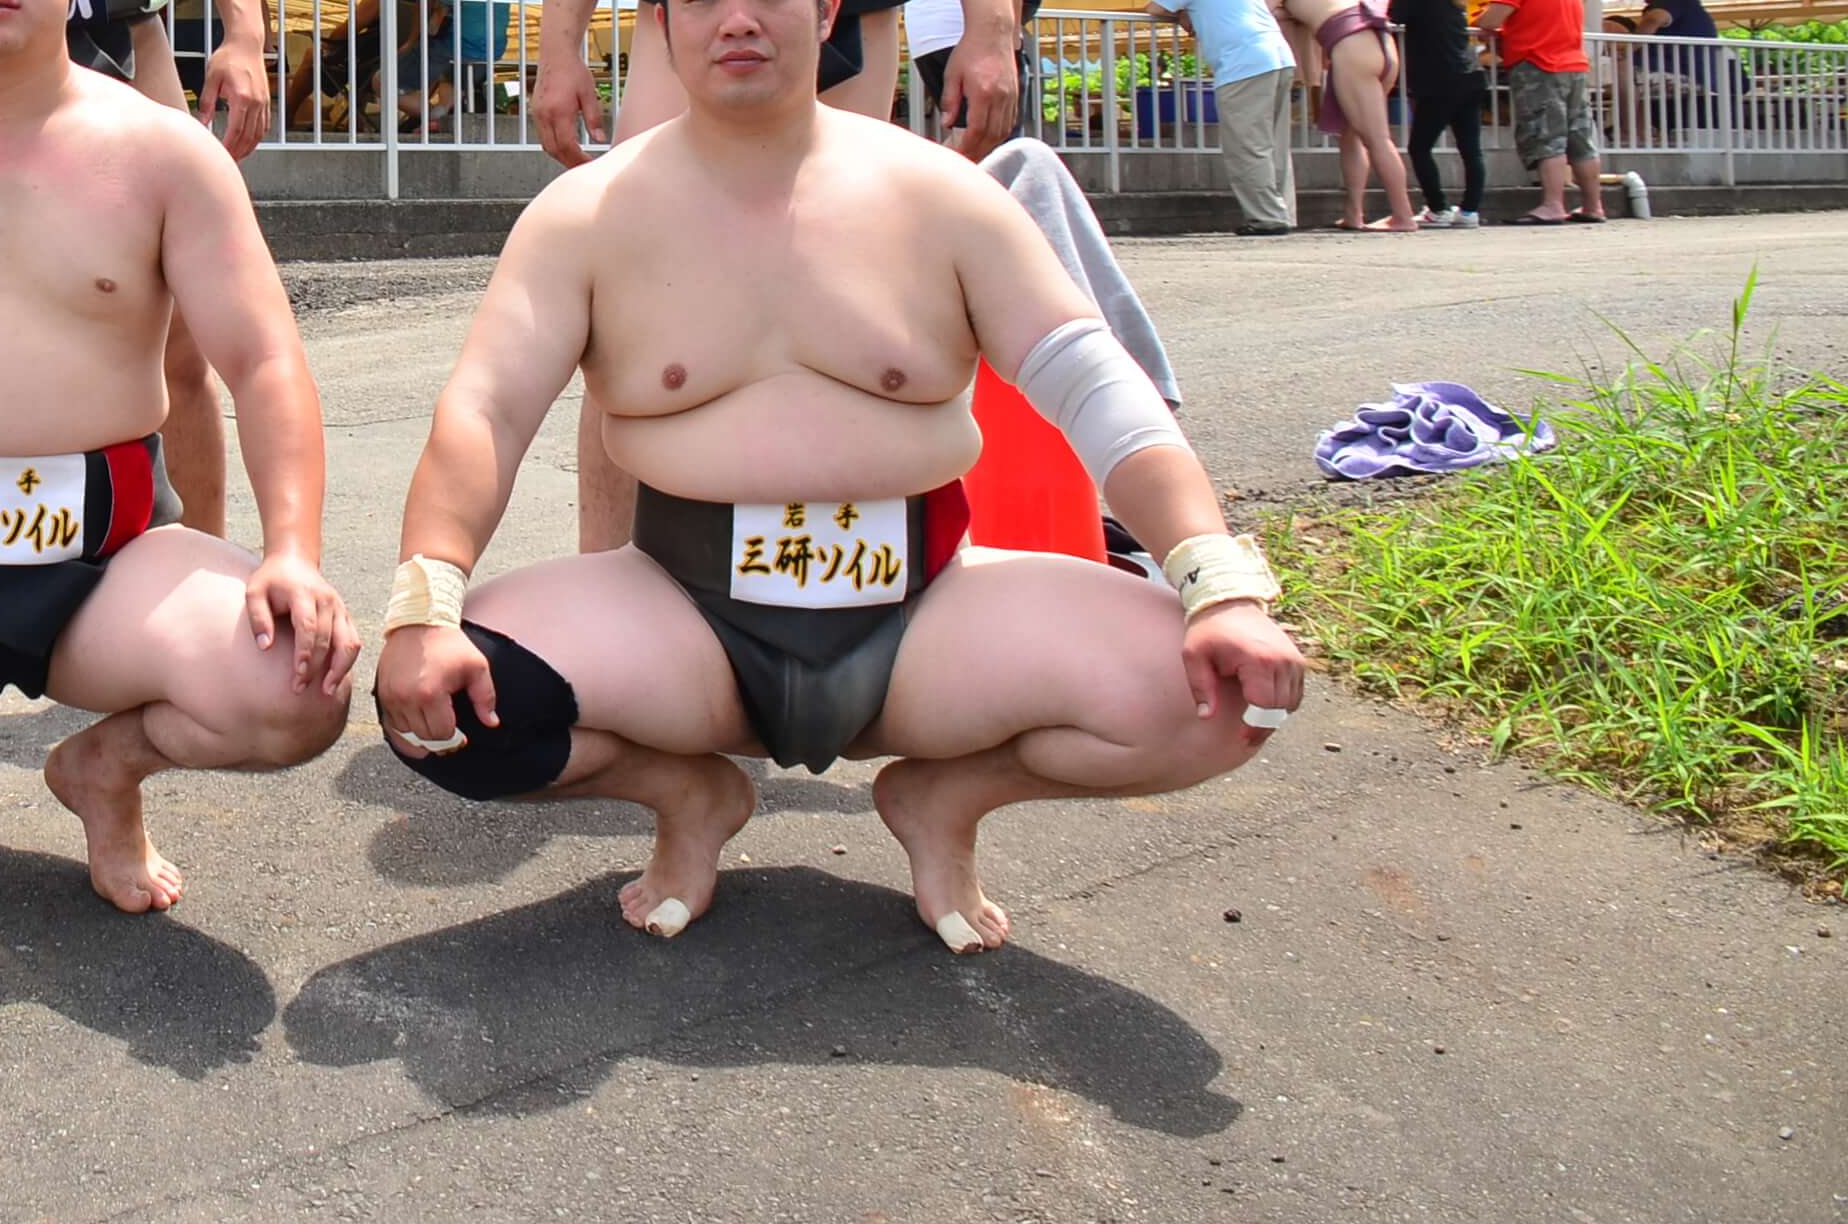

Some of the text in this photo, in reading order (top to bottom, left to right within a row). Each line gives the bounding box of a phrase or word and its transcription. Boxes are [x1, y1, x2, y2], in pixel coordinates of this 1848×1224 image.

[737, 534, 902, 591] 三研ソイル
